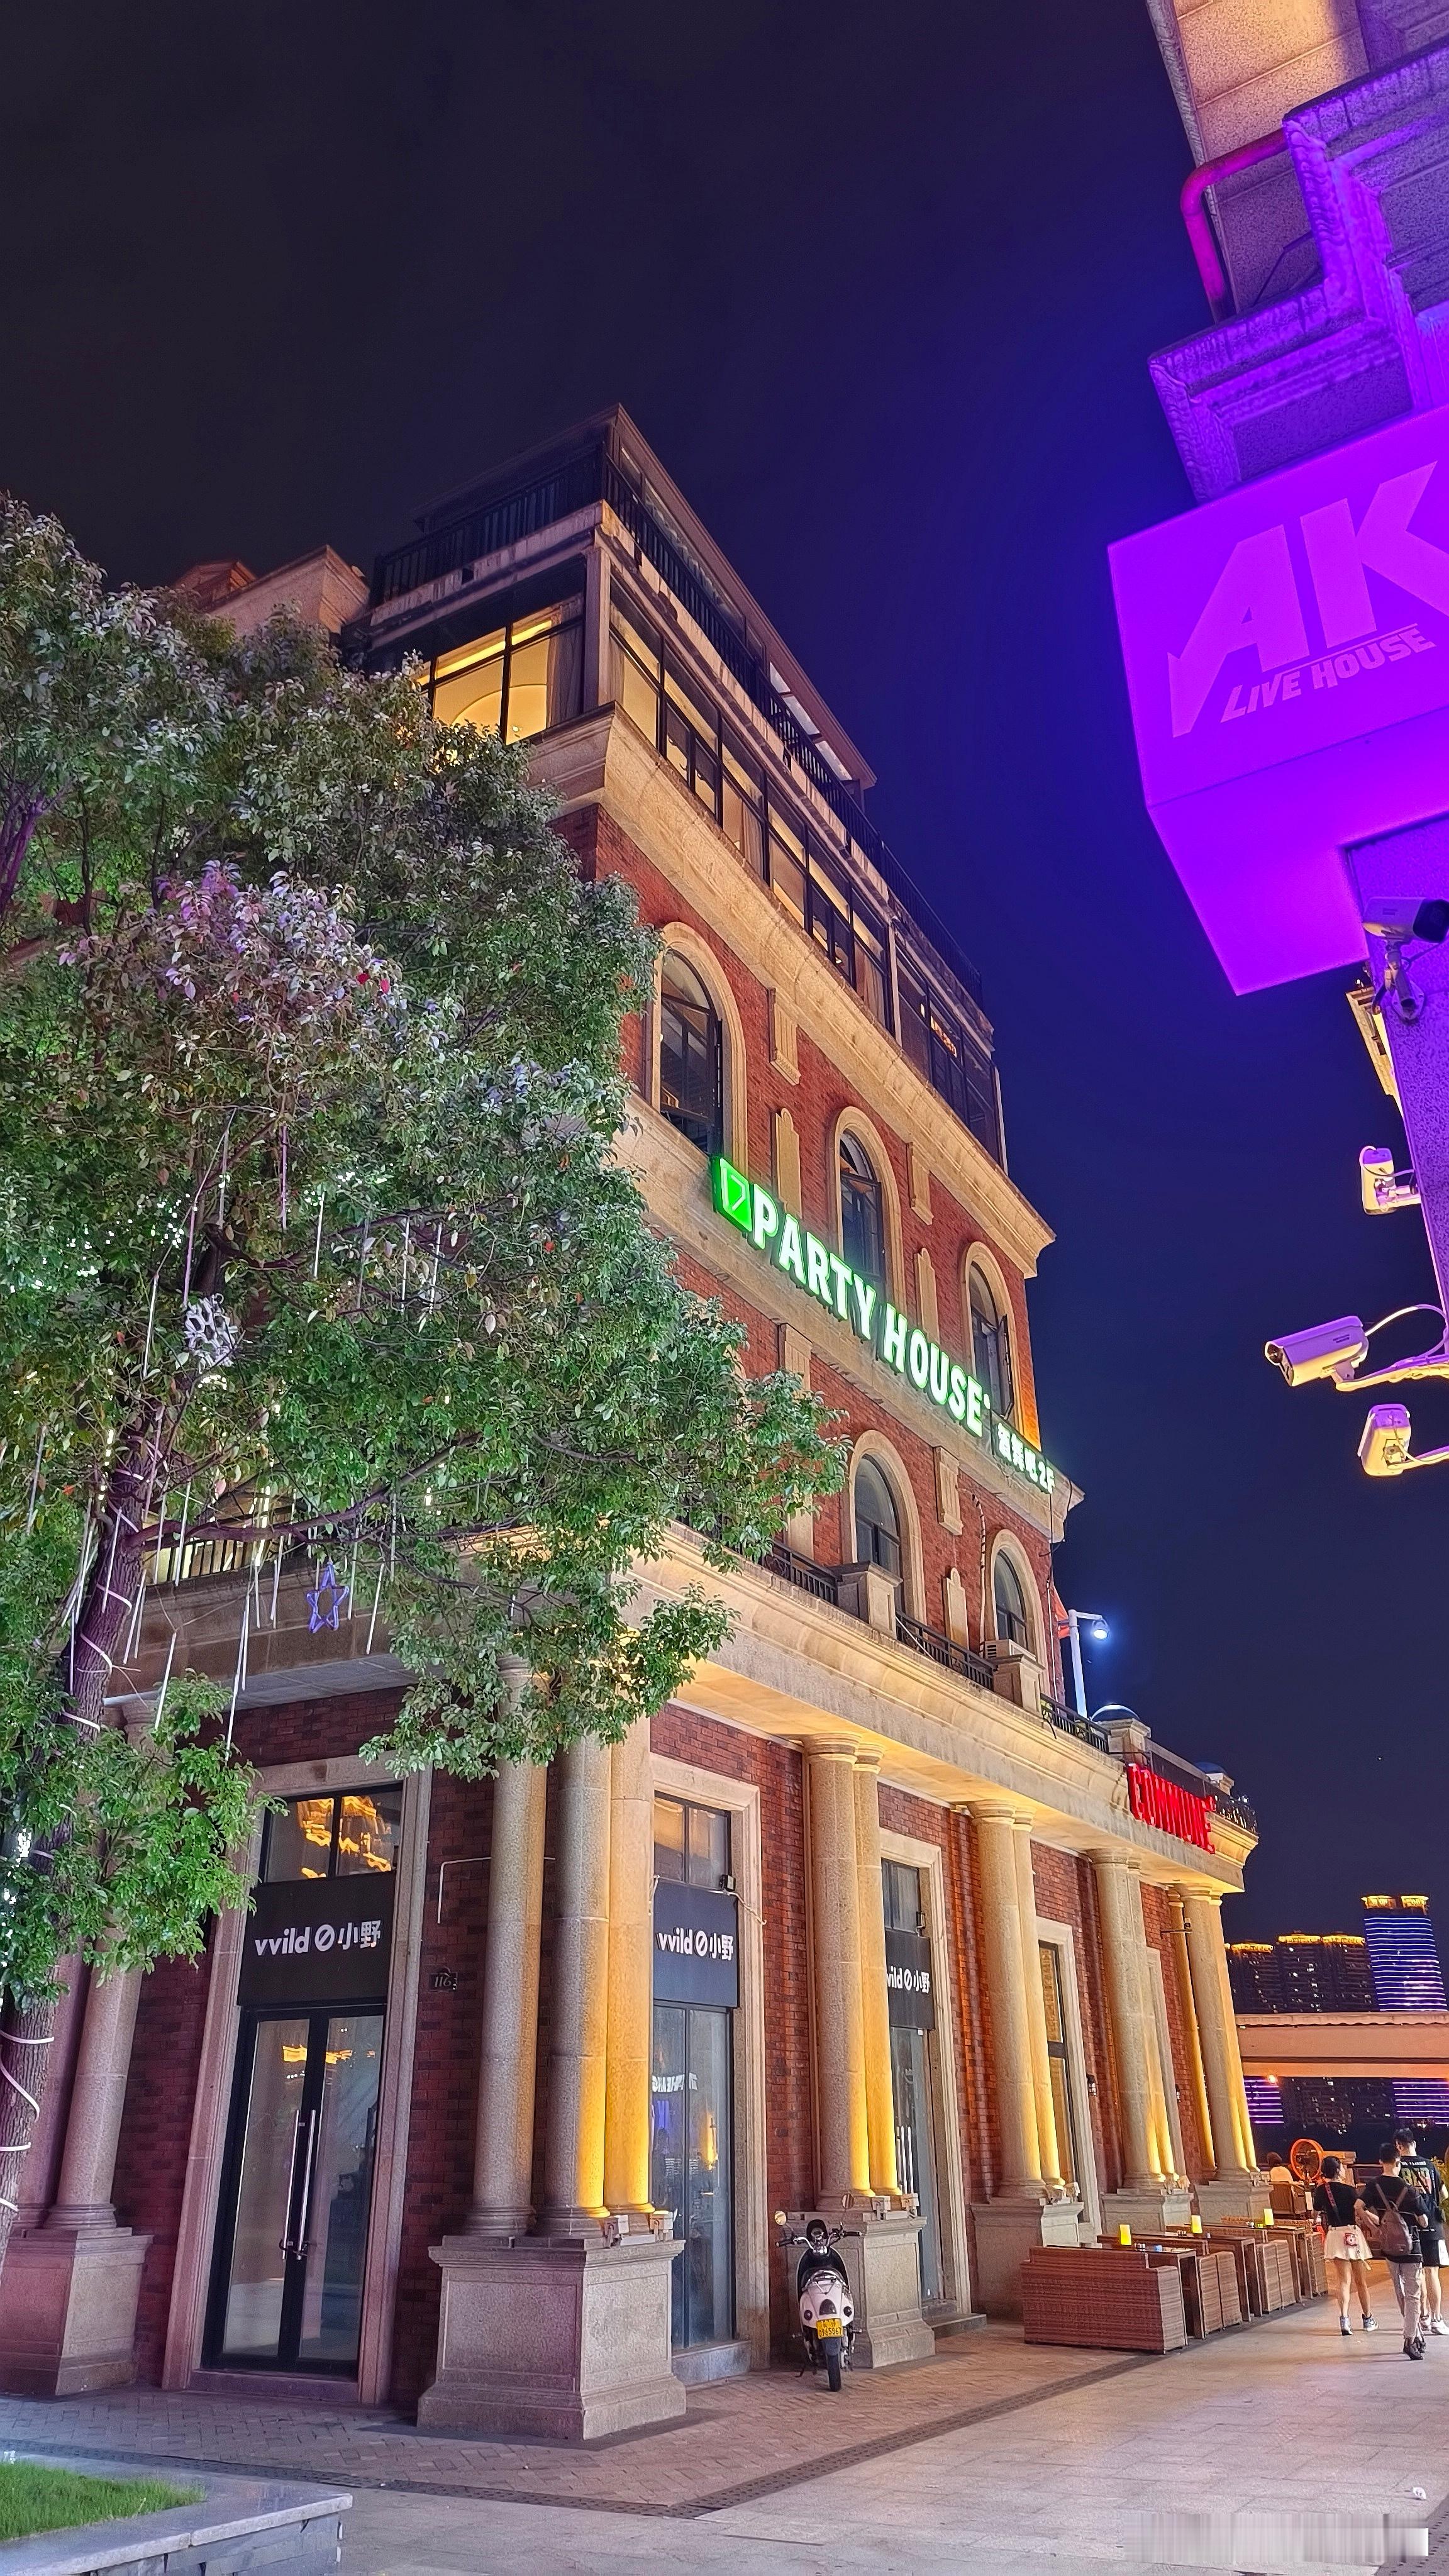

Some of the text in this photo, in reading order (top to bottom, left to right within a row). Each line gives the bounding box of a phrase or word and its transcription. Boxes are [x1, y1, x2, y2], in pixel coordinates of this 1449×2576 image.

[1168, 460, 1449, 737] AK
[1220, 628, 1437, 723] LIVE HOUSE
[753, 1183, 983, 1438] PARTY HOUSE
[338, 1920, 381, 1950] 小野
[709, 1933, 734, 1961] 小野
[913, 1970, 930, 1994] 小野
